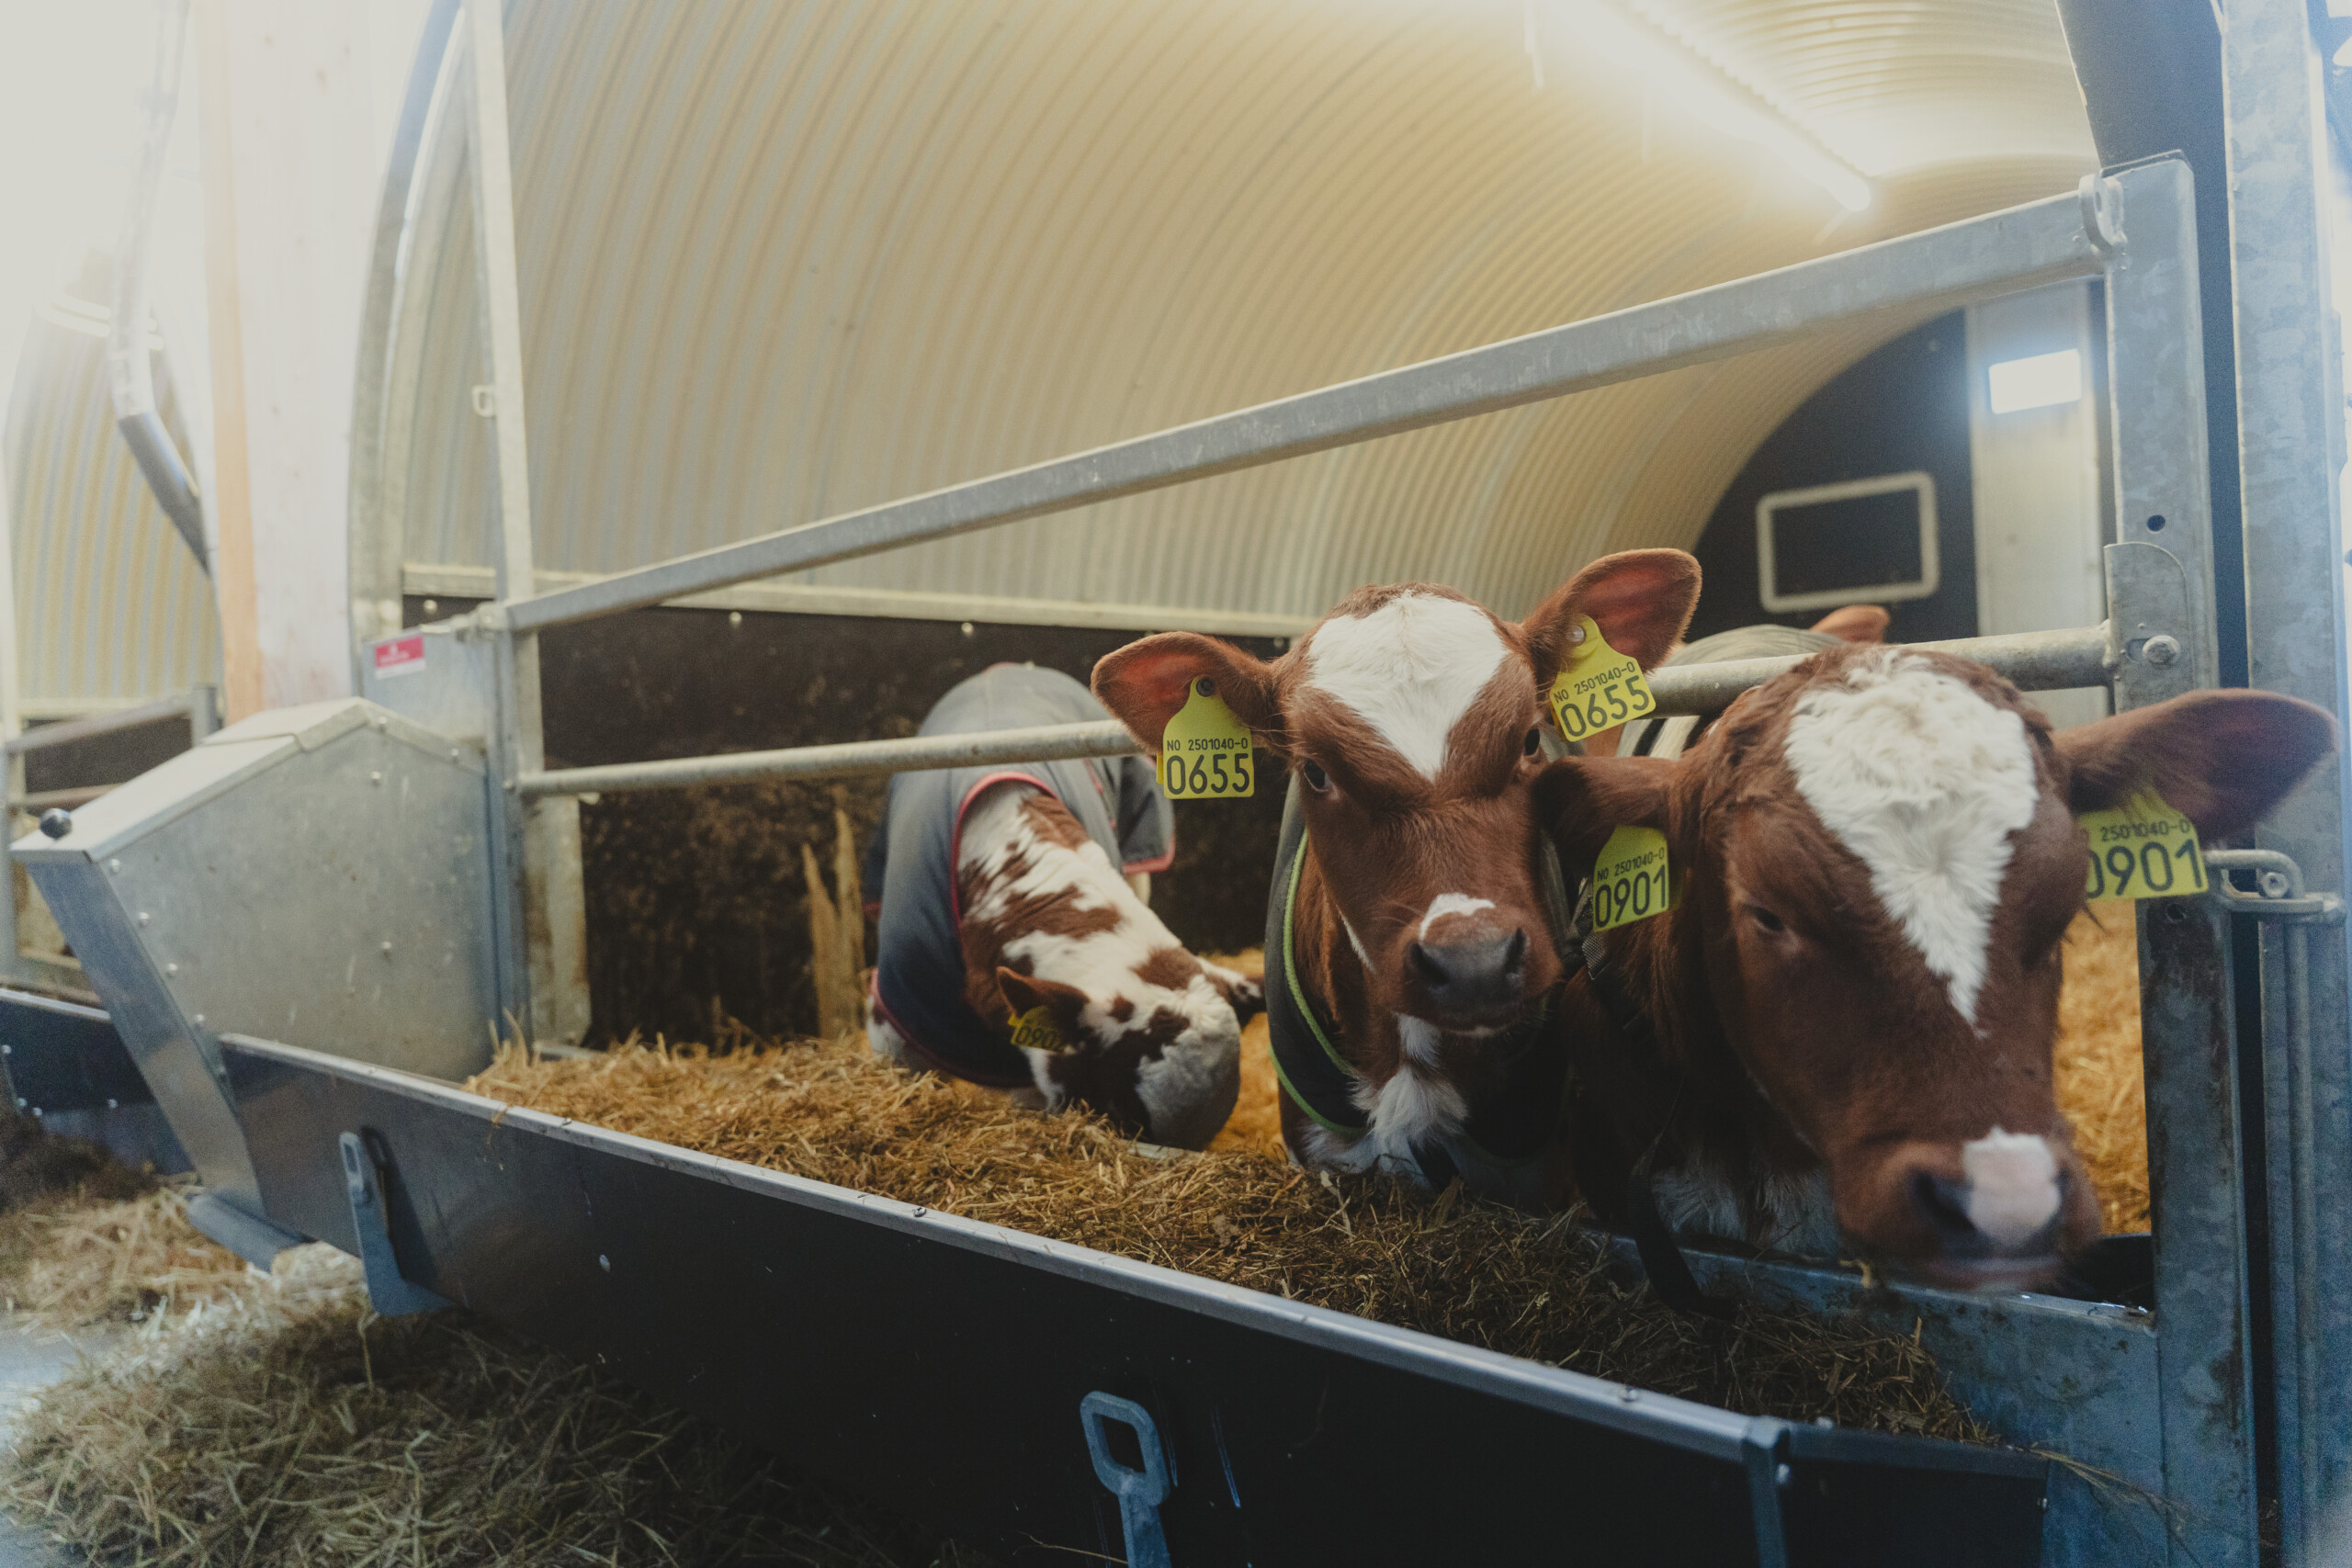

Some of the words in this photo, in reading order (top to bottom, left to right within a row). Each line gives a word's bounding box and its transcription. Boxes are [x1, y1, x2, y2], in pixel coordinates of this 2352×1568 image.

[1554, 689, 1569, 704] NO
[1574, 661, 1635, 695] 2501040-0
[1560, 675, 1649, 737] 0655
[1167, 739, 1181, 751] NO
[1188, 738, 1248, 750] 2501040-0
[1166, 753, 1250, 795] 0655
[2100, 818, 2190, 841] 2501040-0
[1597, 867, 1609, 882] NO
[1614, 847, 1664, 876] 2501040-0
[1595, 864, 1665, 928] 0901
